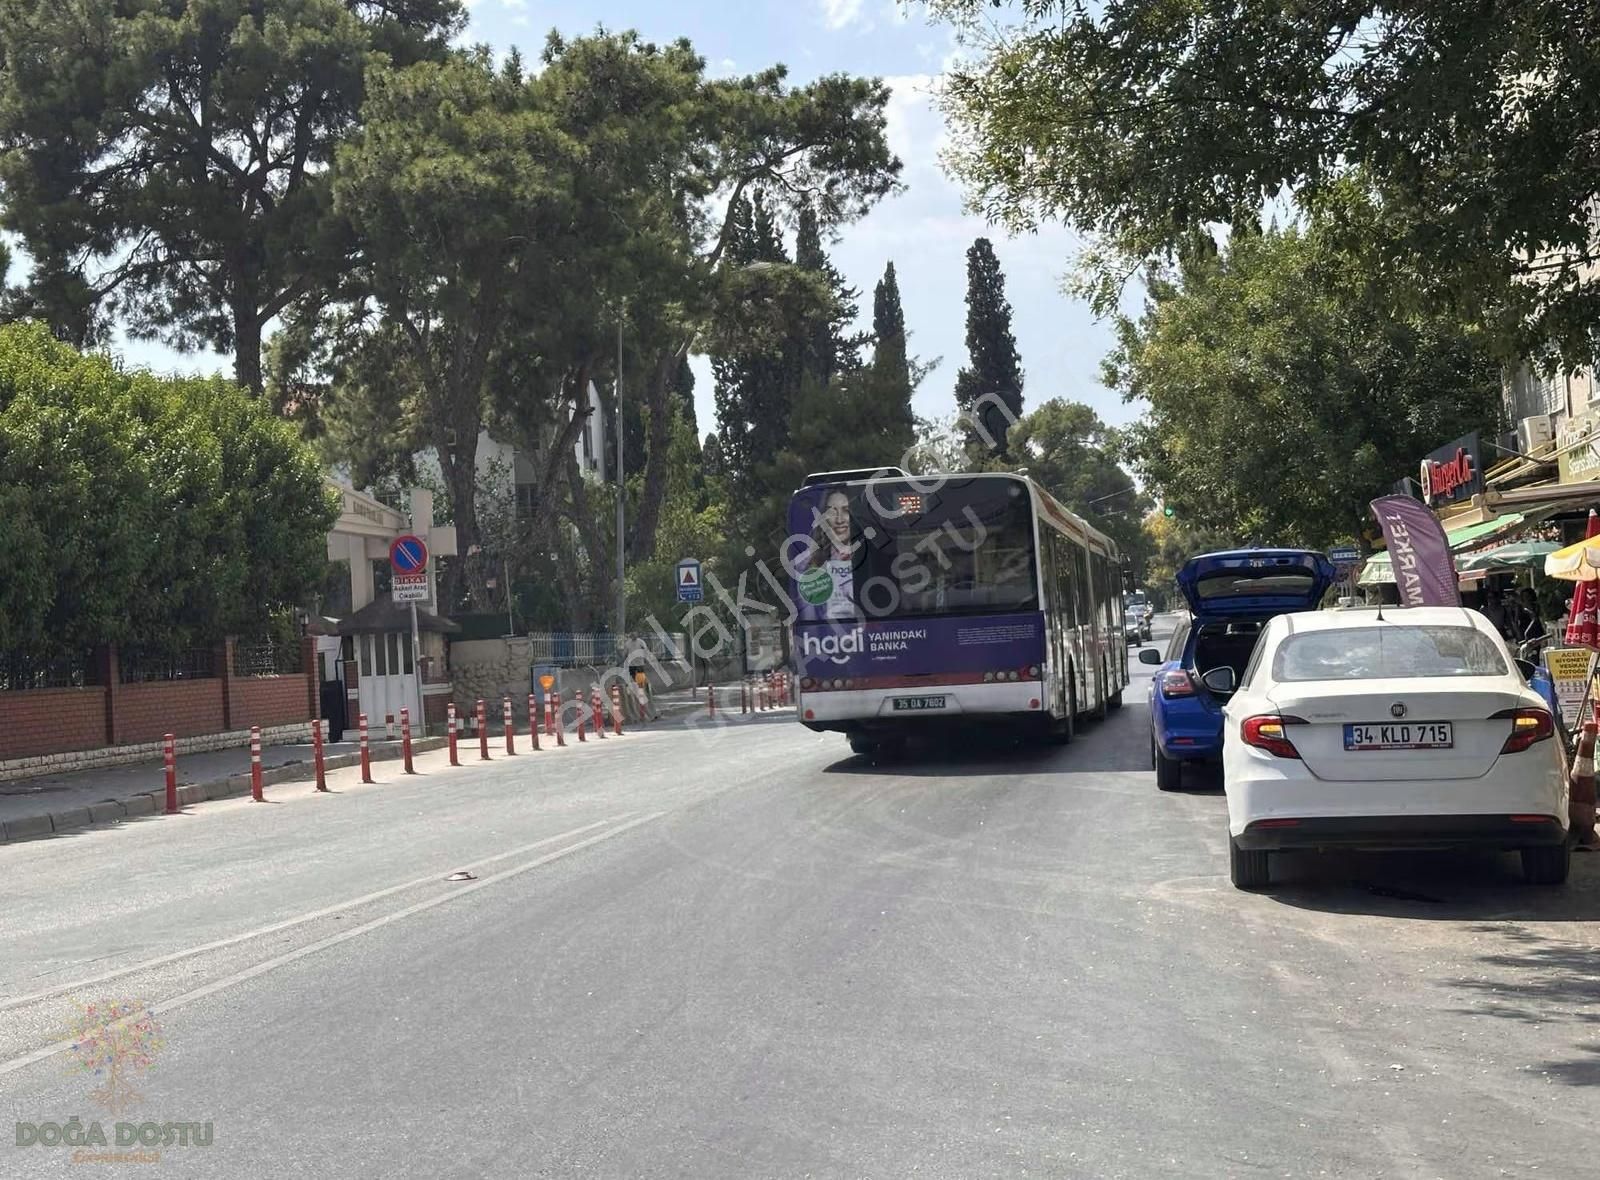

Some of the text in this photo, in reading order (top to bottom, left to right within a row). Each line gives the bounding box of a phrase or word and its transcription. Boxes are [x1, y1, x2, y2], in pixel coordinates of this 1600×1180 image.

[868, 629, 927, 641] YANINDAKİ
[803, 627, 865, 659] hadi
[870, 641, 908, 652] BANKA
[1354, 725, 1447, 744] 34 KLD 715
